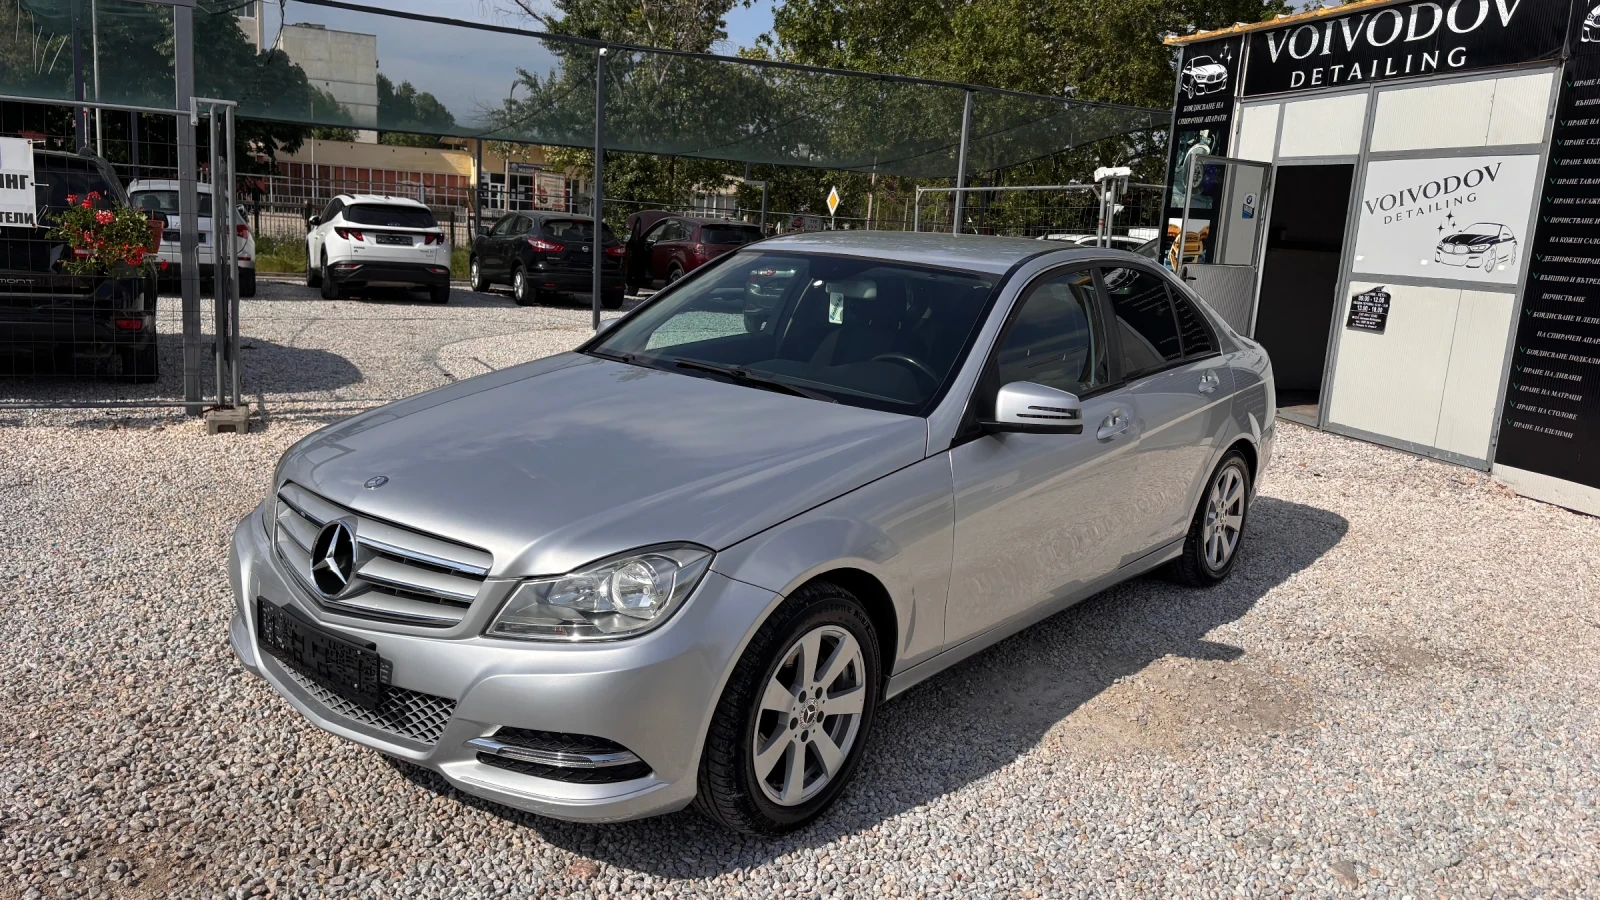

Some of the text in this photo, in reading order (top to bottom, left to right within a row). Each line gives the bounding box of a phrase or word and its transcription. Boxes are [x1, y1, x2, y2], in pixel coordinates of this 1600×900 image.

[1265, 0, 1520, 64] VOIVODOV
[1290, 46, 1467, 88] DETAILING
[1567, 118, 1588, 127] ПРАНЕ
[1564, 138, 1584, 147] ПРАНЕ
[1560, 158, 1582, 166] ПРАНЕ
[1556, 178, 1578, 186] ПРАНЕ
[1364, 162, 1502, 215] VOIVODOV
[1553, 196, 1575, 205] ПРАНЕ
[1384, 192, 1477, 225] DETAILING
[1550, 216, 1594, 226] ПОЧИСТВАНЕ
[1559, 236, 1584, 244] КОЖЕН
[1542, 254, 1600, 265] ДЕЗИНФЕКЦИРАН
[1540, 274, 1569, 283] ВЪНШНО
[1542, 292, 1586, 303] ПОЧИСТВАНЕ
[1532, 311, 1575, 322] БОЯДИСВАНЕ
[1536, 330, 1600, 346] НА СПИРАЧЕН АПАР
[1526, 348, 1568, 360] БОЯДИСВАНЕ
[1522, 366, 1544, 376] ПРАНЕ
[1553, 371, 1582, 382] ДИВАНИ
[1520, 384, 1582, 402] ПРАНЕ НА МАТРАЦИ
[1516, 402, 1578, 420] ПРАНЕ НА СТОЛОВЕ
[1513, 421, 1573, 439] ПРАНЕ НА КИЛИМИ
